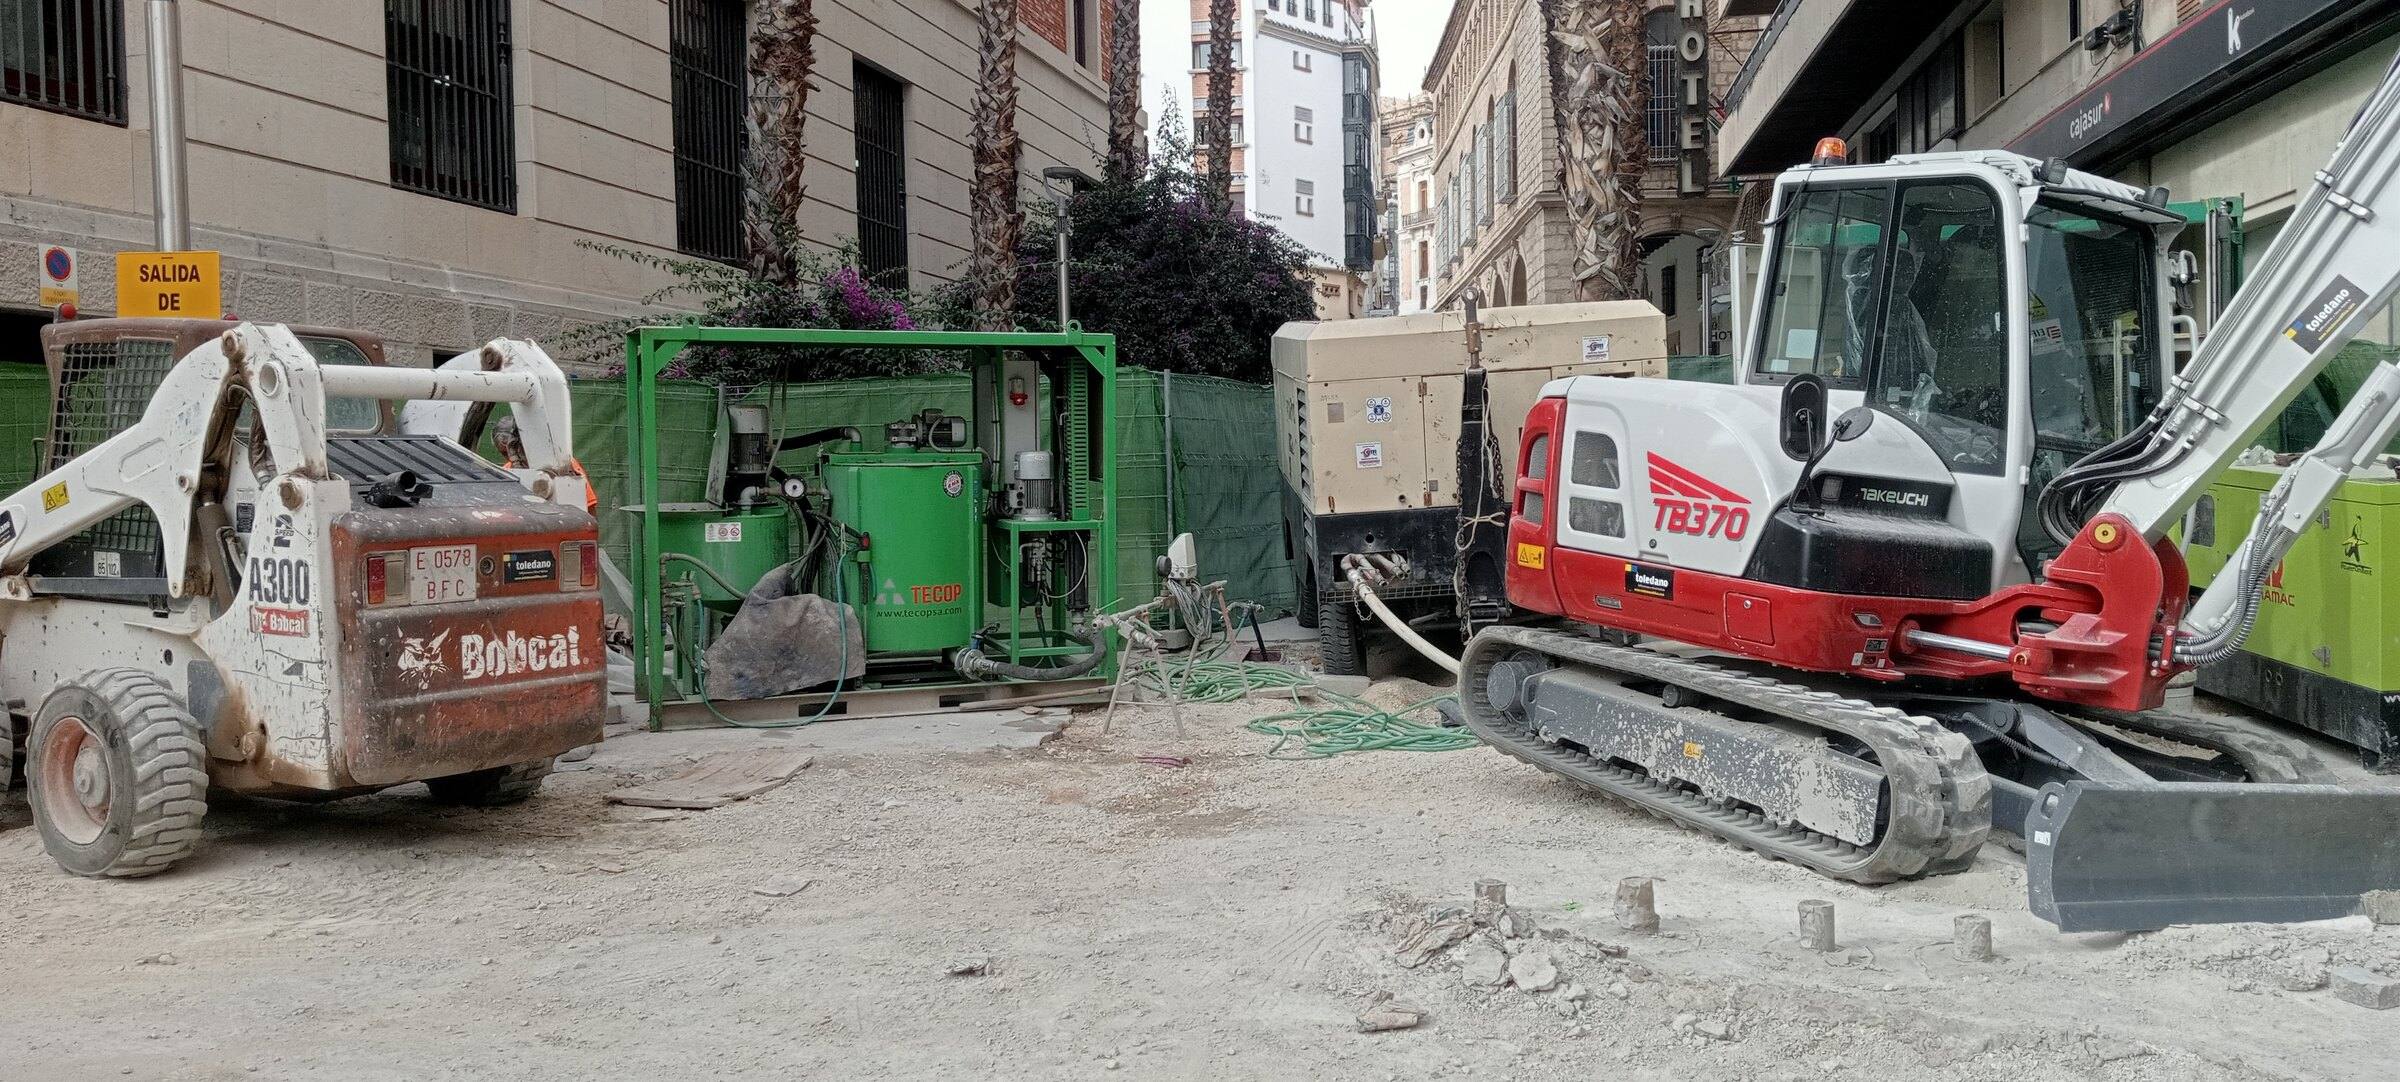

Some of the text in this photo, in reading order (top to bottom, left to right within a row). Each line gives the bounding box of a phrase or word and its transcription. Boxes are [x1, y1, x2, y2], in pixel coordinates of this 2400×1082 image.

[2069, 101, 2104, 140] cajasur
[139, 264, 201, 283] SALIDA
[158, 292, 181, 311] DE
[2305, 288, 2350, 332] toledano
[1652, 497, 1751, 542] TB370
[274, 528, 295, 537] SPEED
[416, 549, 472, 571] E 0578
[515, 560, 552, 570] toledano
[248, 557, 310, 606] A300
[1635, 571, 1669, 588] toledano
[911, 583, 963, 605] TECOP
[2261, 591, 2295, 607] AMAC
[269, 612, 305, 633] Bobcat
[876, 606, 962, 618] www.tecopsa.com
[460, 625, 581, 680] Bobcat
